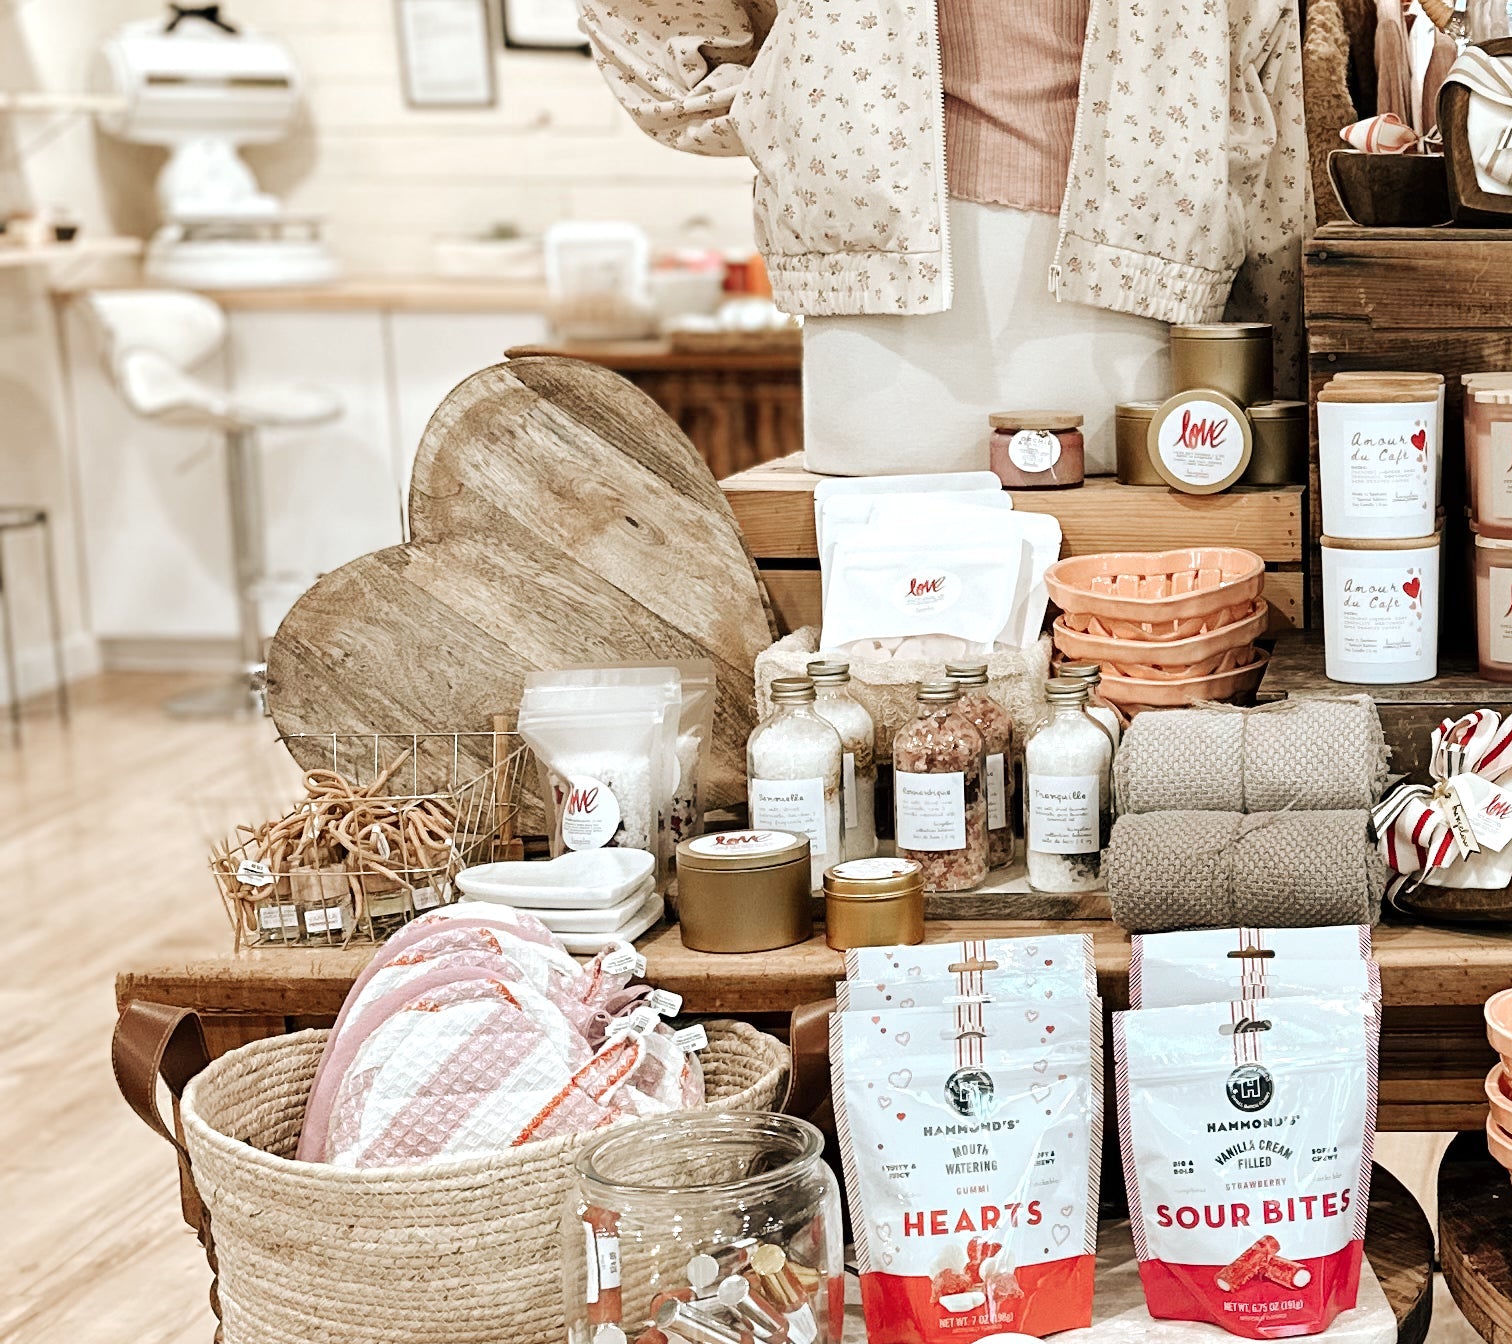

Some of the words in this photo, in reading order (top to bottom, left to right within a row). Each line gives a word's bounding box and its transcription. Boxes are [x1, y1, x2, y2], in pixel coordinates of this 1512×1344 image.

[1173, 409, 1228, 449] love
[1351, 432, 1407, 447] Amour
[1351, 448, 1369, 461] du
[904, 576, 946, 598] love
[1344, 578, 1399, 593] Amour
[1344, 595, 1360, 607] du
[1034, 789, 1086, 805] Tranquille
[952, 1143, 989, 1158] MOUTH
[1214, 1139, 1256, 1166] VANILLA
[1258, 1139, 1294, 1160] CREAM
[945, 1160, 998, 1175] WATERING
[1238, 1156, 1272, 1170] FILLED
[956, 1185, 990, 1196] GUMMI
[1225, 1178, 1287, 1191] STRAWBERRY
[1156, 1203, 1250, 1229] SOUR
[1263, 1188, 1351, 1224] BITES
[904, 1200, 1043, 1237] HEARTS
[1224, 1301, 1237, 1312] NET
[1251, 1301, 1268, 1313] 6.75
[1269, 1301, 1280, 1312] OZ
[939, 1318, 954, 1328] NET
[972, 1315, 977, 1325] 7
[978, 1315, 988, 1324] OZ
